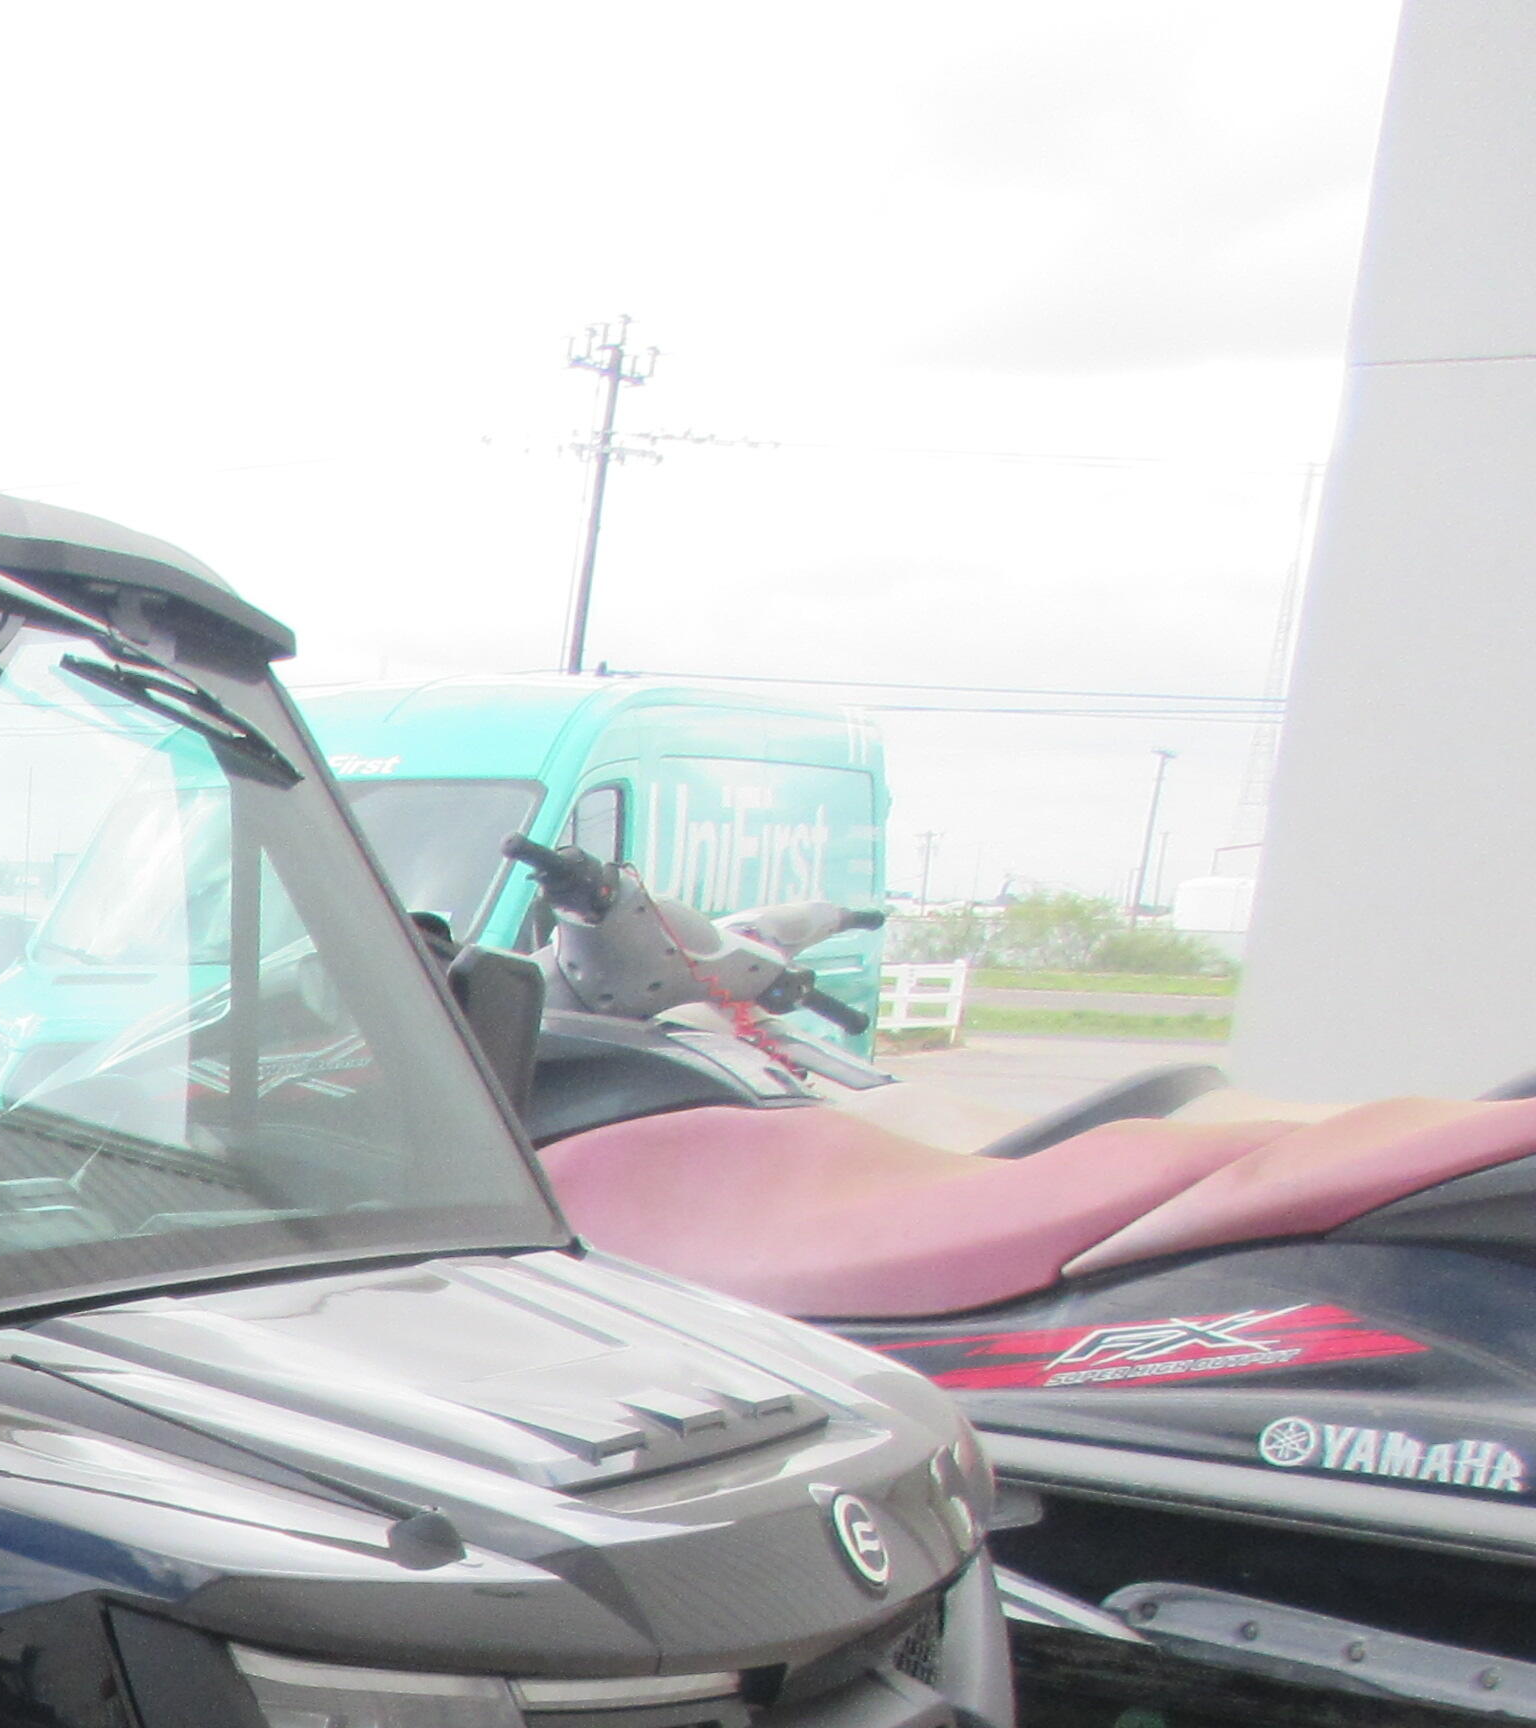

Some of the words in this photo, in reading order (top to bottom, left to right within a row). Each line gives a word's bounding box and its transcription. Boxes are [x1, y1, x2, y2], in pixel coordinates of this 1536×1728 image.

[645, 781, 830, 916] UniFirst
[1043, 1366, 1131, 1387] SUPER
[1127, 1357, 1194, 1379] HIGH
[1191, 1348, 1303, 1373] OUTPUT
[1044, 1303, 1311, 1372] FX
[1320, 1422, 1525, 1493] YAMAHA
